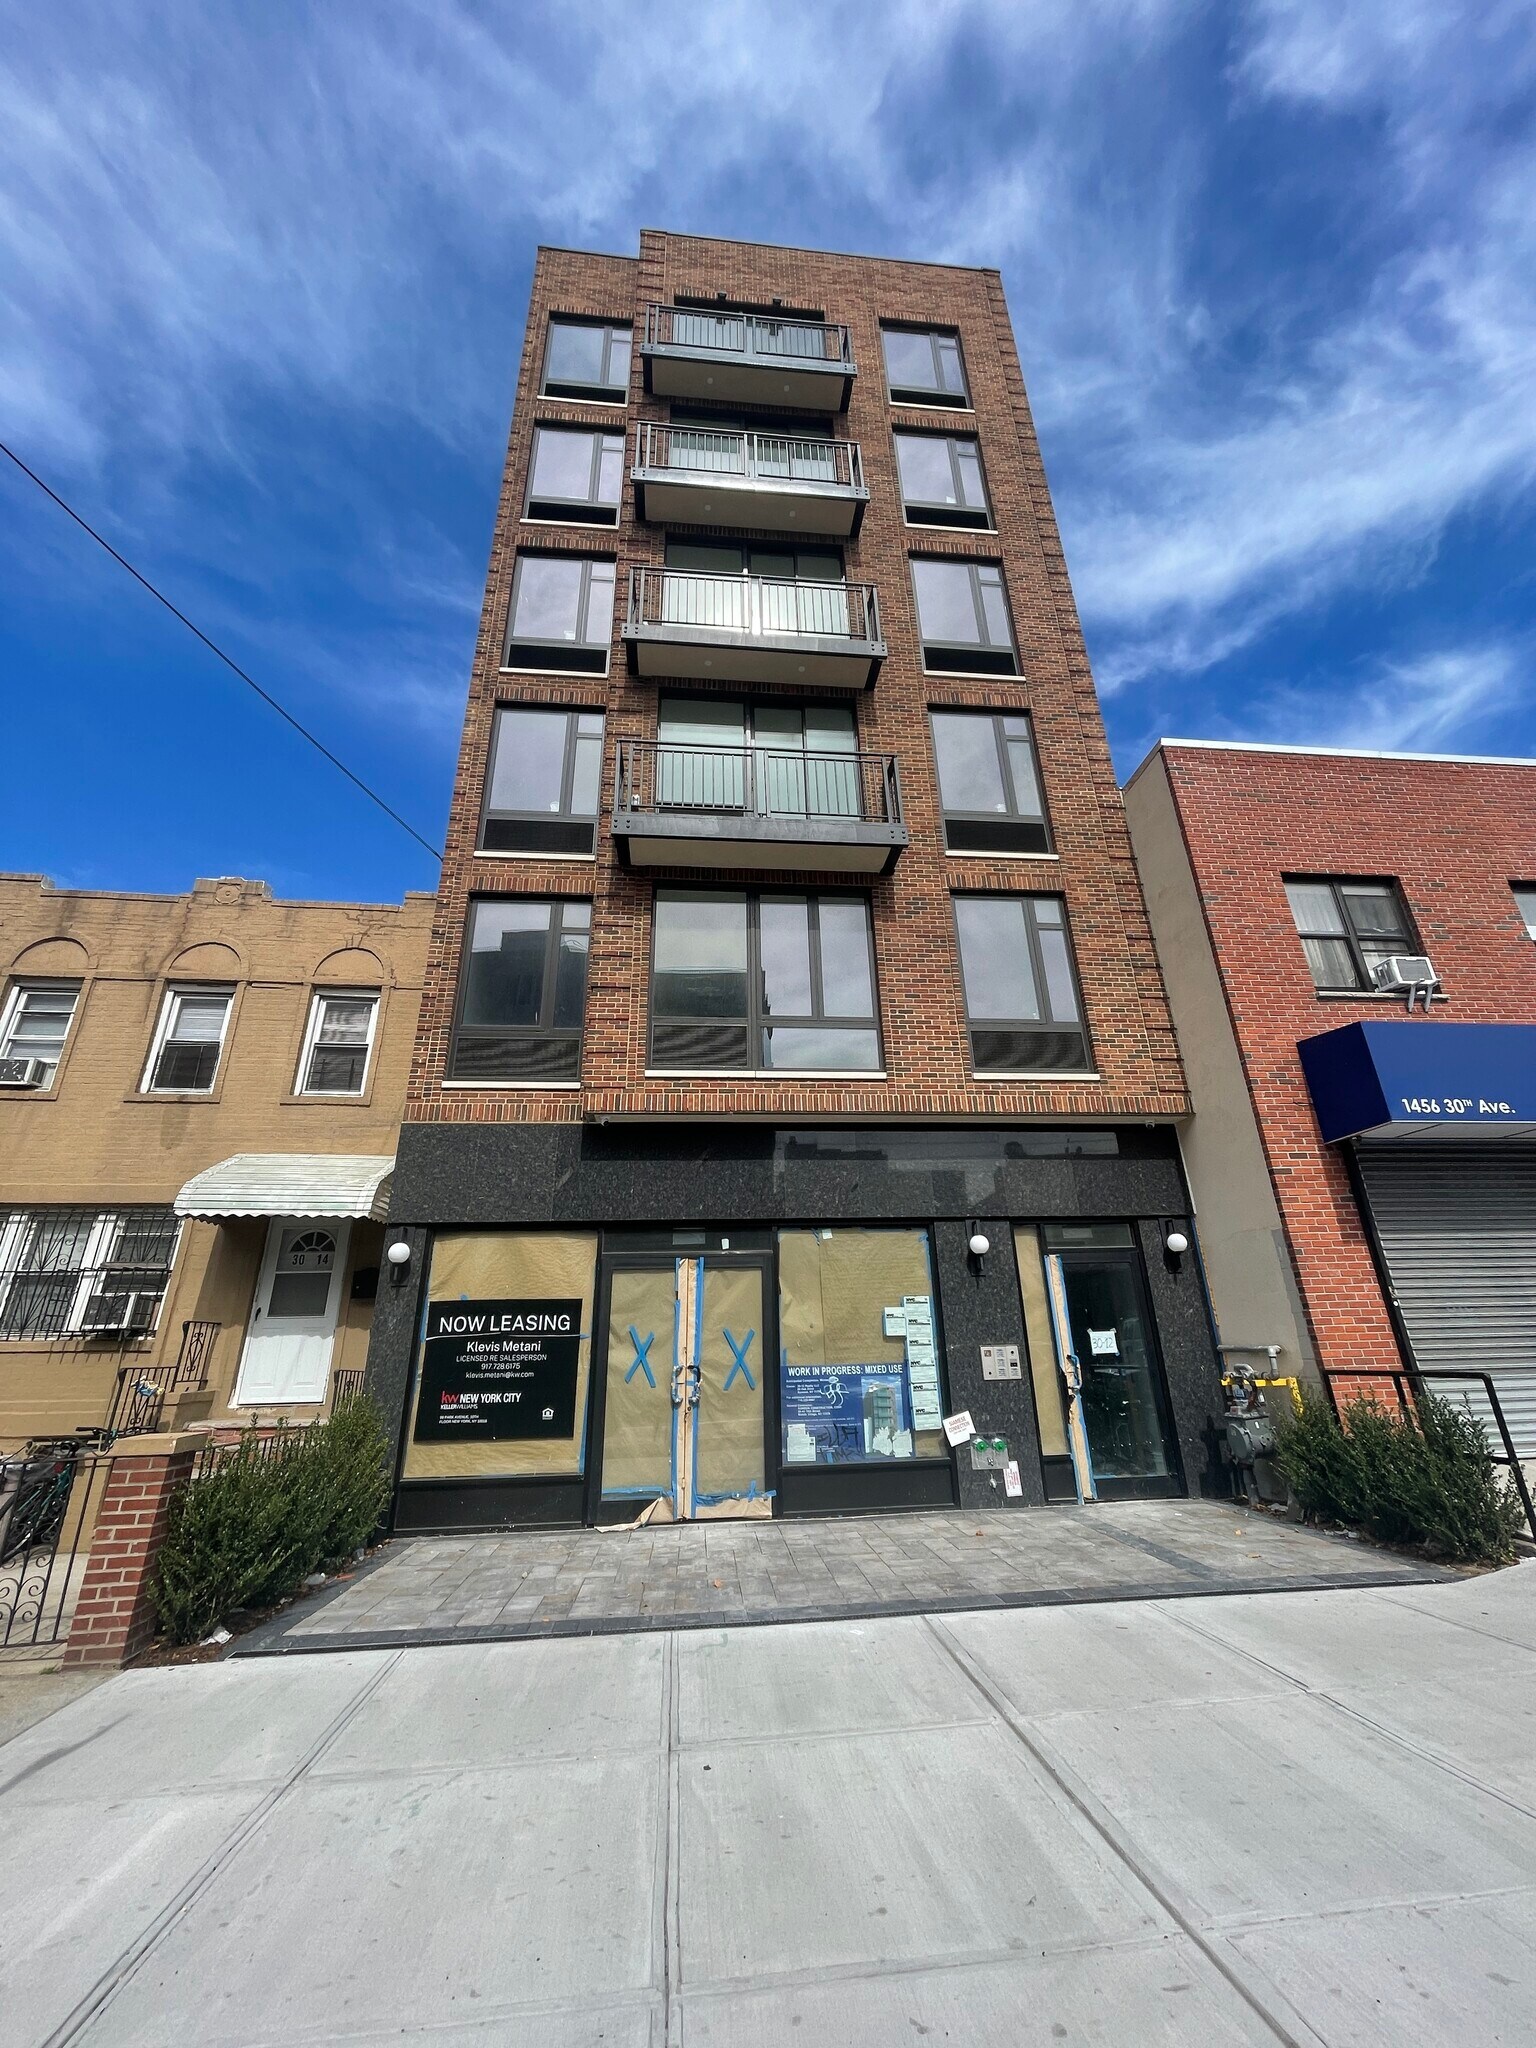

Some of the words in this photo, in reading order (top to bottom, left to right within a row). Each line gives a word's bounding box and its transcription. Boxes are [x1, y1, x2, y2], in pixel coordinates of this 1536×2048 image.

[1401, 1099, 1441, 1114] 1456
[1479, 1100, 1516, 1114] Ave.
[292, 1254, 305, 1265] 30
[317, 1254, 328, 1264] 14
[439, 1315, 486, 1333] NOW
[489, 1314, 571, 1332] LEASING
[466, 1342, 500, 1352] Klevis
[502, 1340, 542, 1352] Metani
[456, 1354, 489, 1363] LICENSED
[489, 1354, 499, 1362] RE
[499, 1353, 548, 1362] SALESPERSON
[788, 1367, 811, 1377] WORK
[812, 1366, 820, 1376] IN
[821, 1365, 863, 1375] PROGRESS:
[864, 1365, 887, 1375] MIXED
[888, 1364, 903, 1374] USE
[441, 1391, 459, 1404] kw
[460, 1393, 479, 1404] NEW
[480, 1392, 502, 1404] YORK
[503, 1392, 522, 1403] CITY
